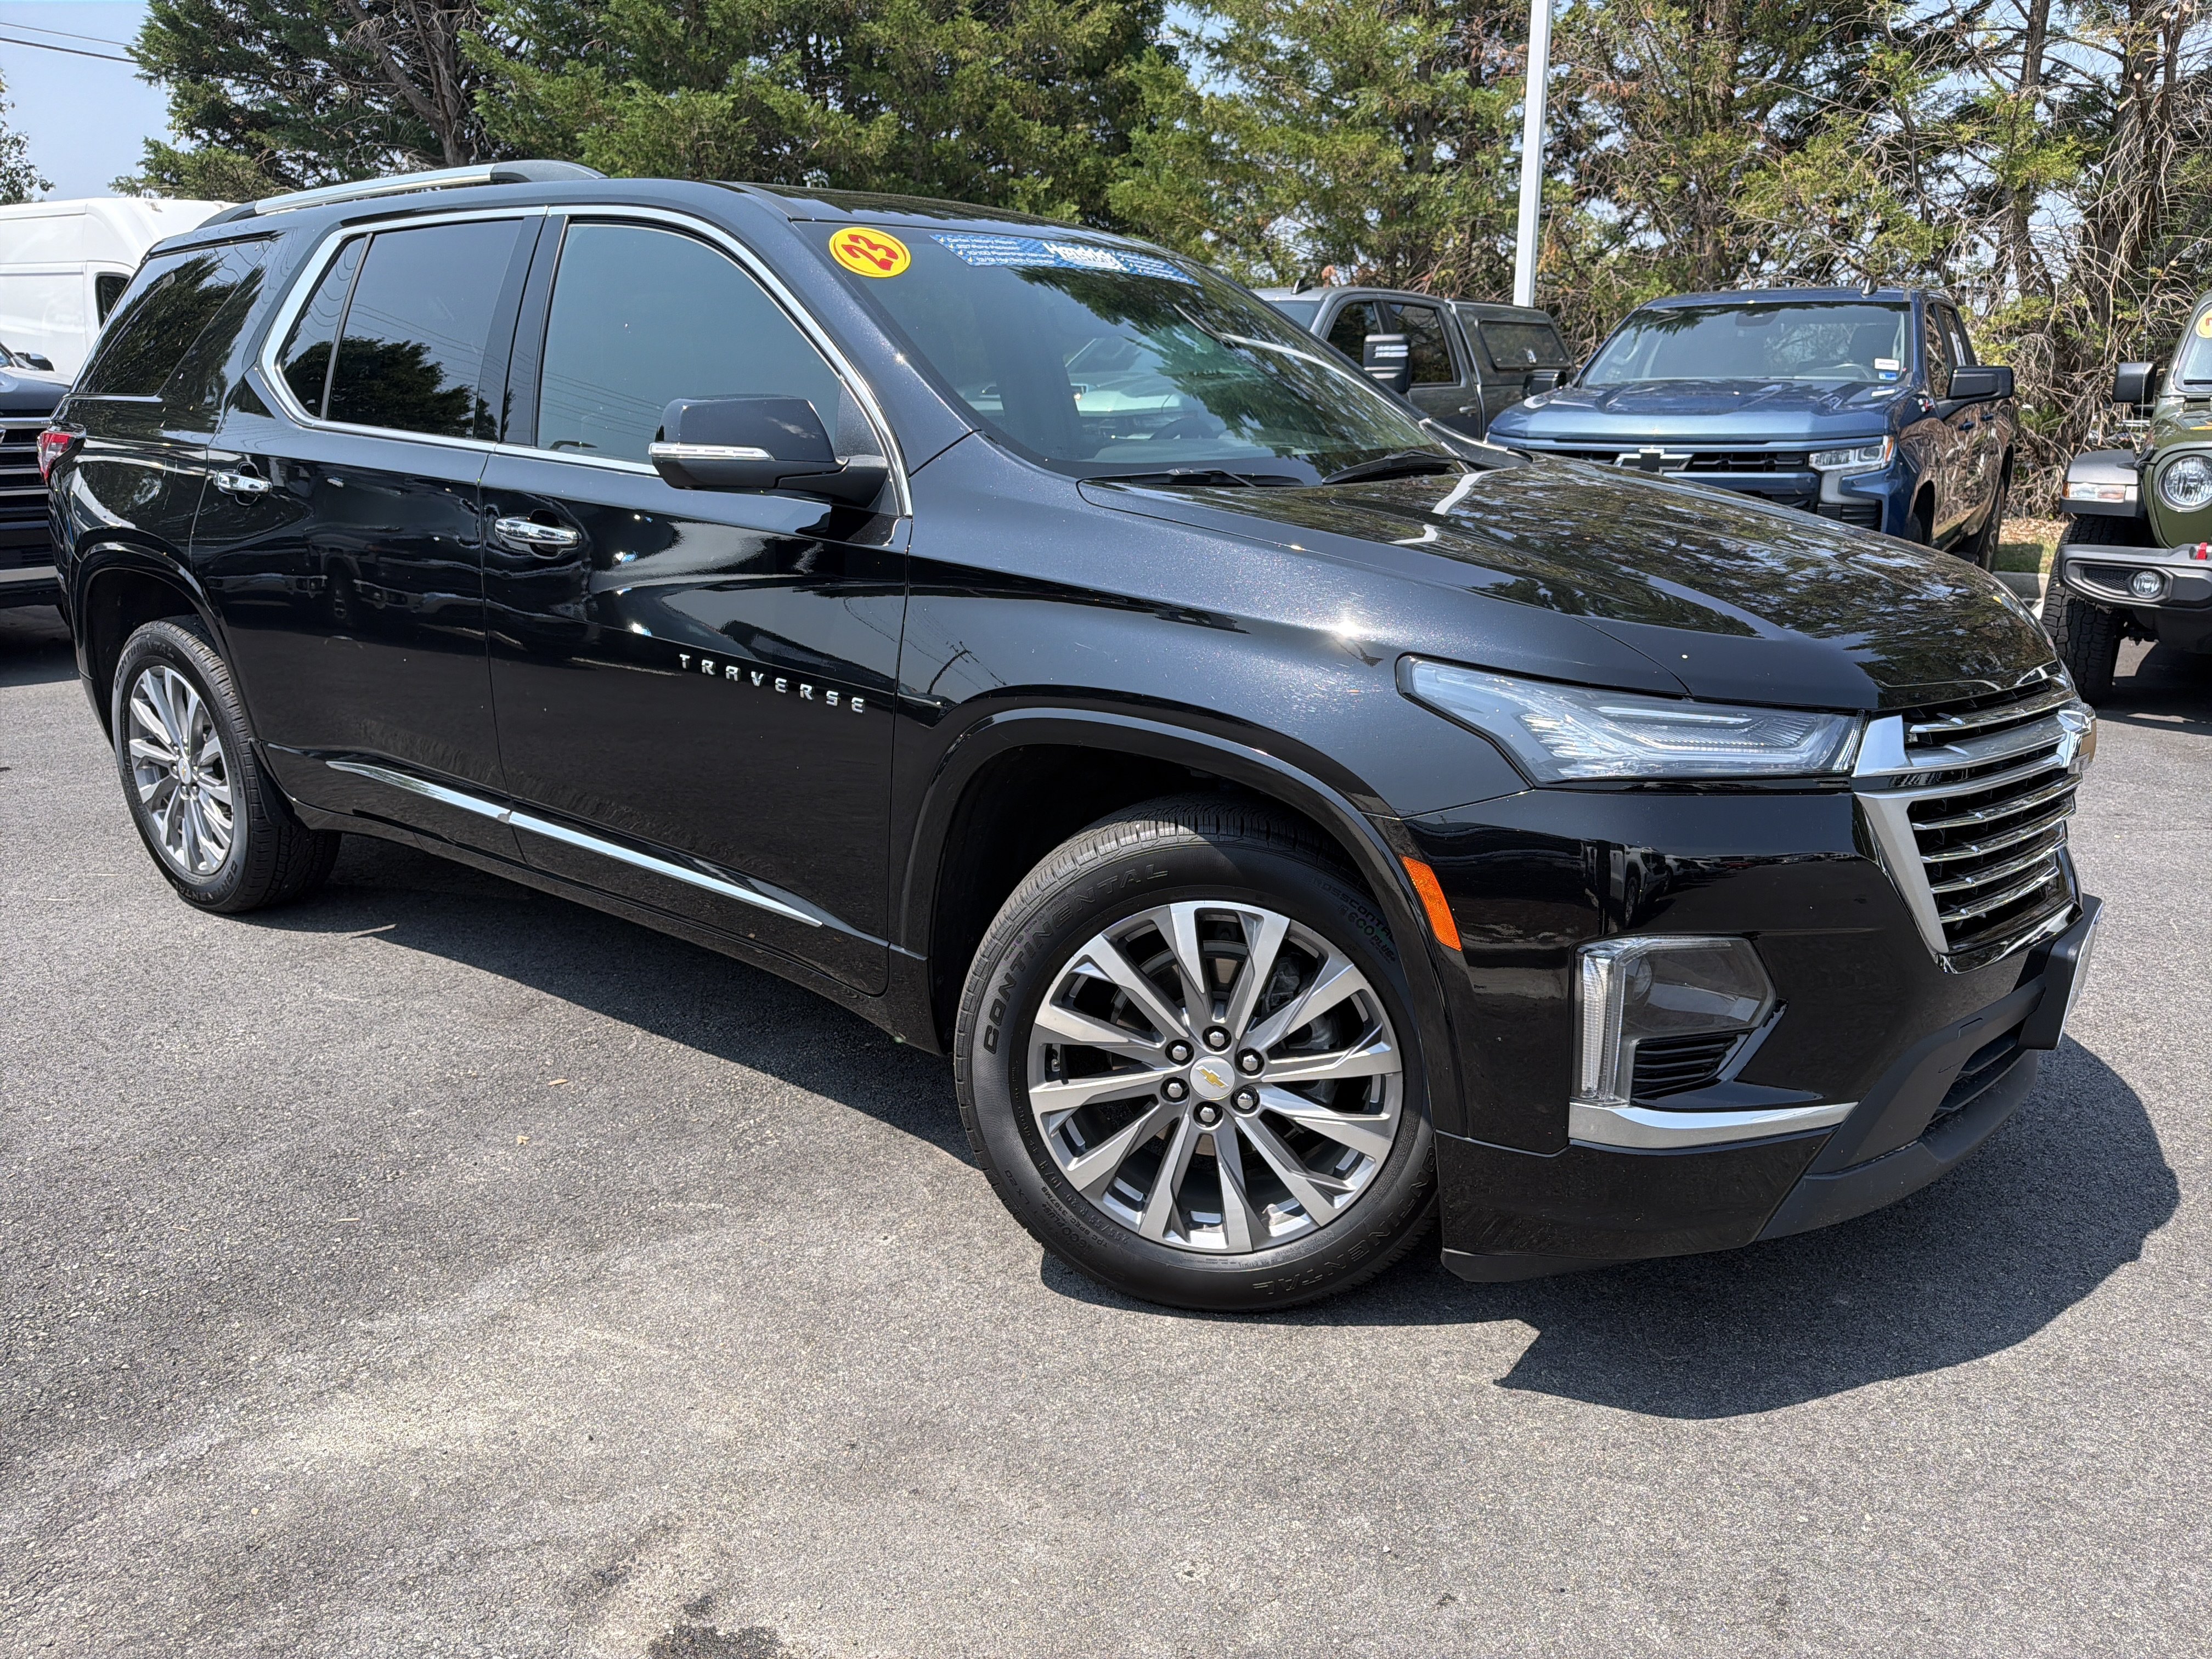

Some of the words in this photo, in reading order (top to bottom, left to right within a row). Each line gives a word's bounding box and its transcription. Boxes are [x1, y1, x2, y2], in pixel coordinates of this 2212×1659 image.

[841, 234, 898, 271] 23
[679, 653, 866, 714] TRAVERSE
[984, 864, 1169, 1054] CONTINENTAL
[1005, 1170, 1018, 1187] 20
[1015, 1188, 1030, 1205] LX
